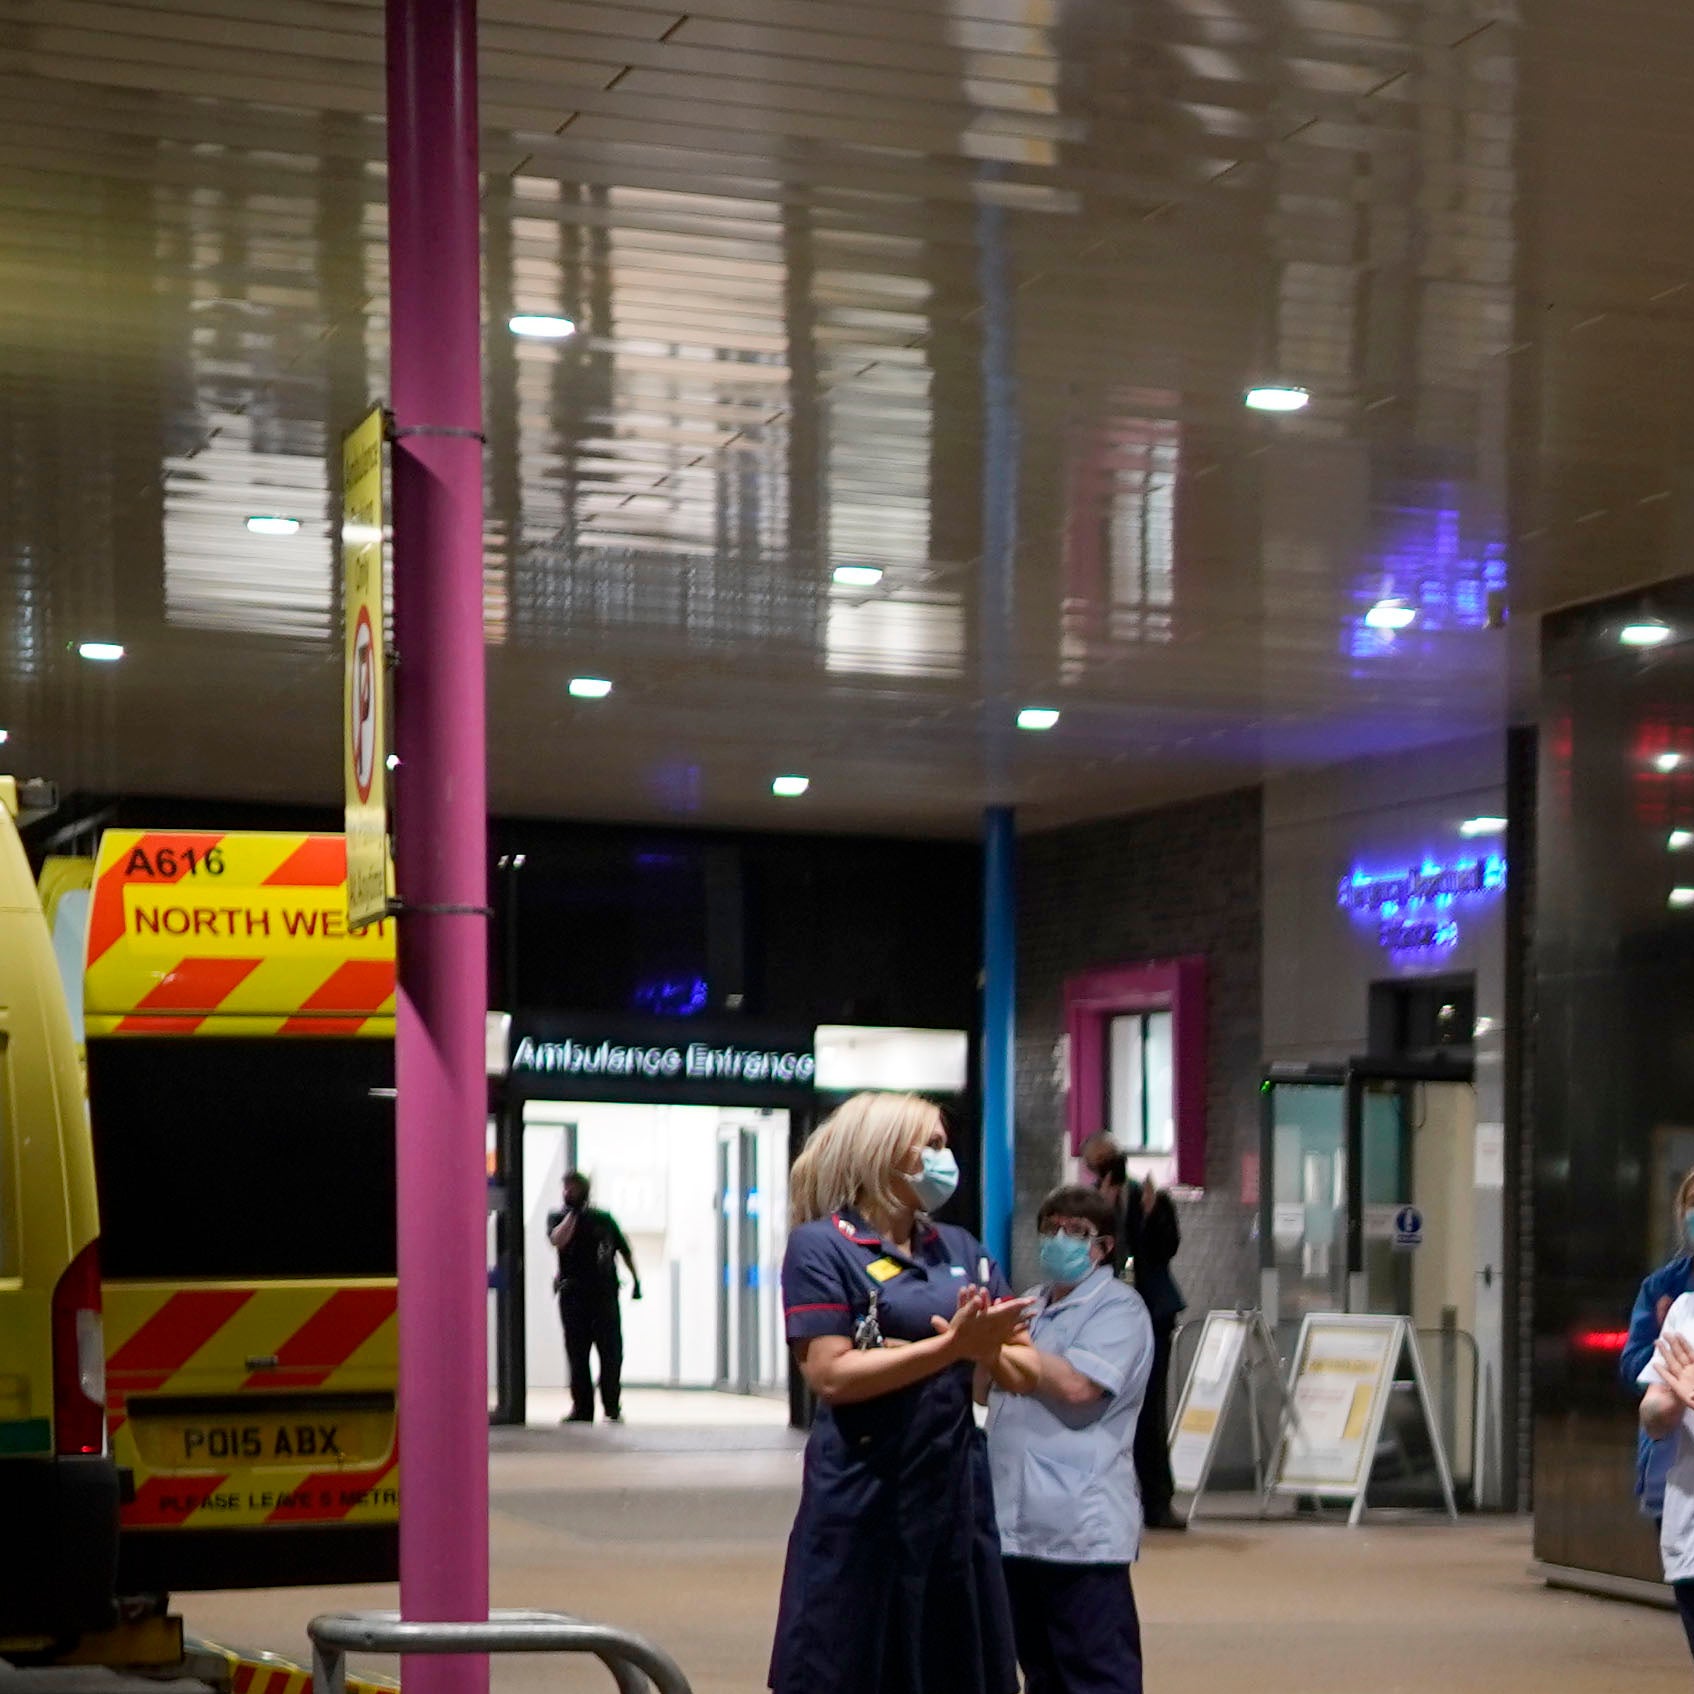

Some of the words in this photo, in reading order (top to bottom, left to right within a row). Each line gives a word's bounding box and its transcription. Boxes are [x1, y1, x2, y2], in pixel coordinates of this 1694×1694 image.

[124, 847, 225, 878] A616
[134, 906, 271, 936] NORTH
[512, 1035, 682, 1076] Ambulance
[686, 1041, 816, 1081] Entrance
[183, 1425, 262, 1459] PO15
[274, 1423, 341, 1456] ABX
[340, 1487, 398, 1507] METR
